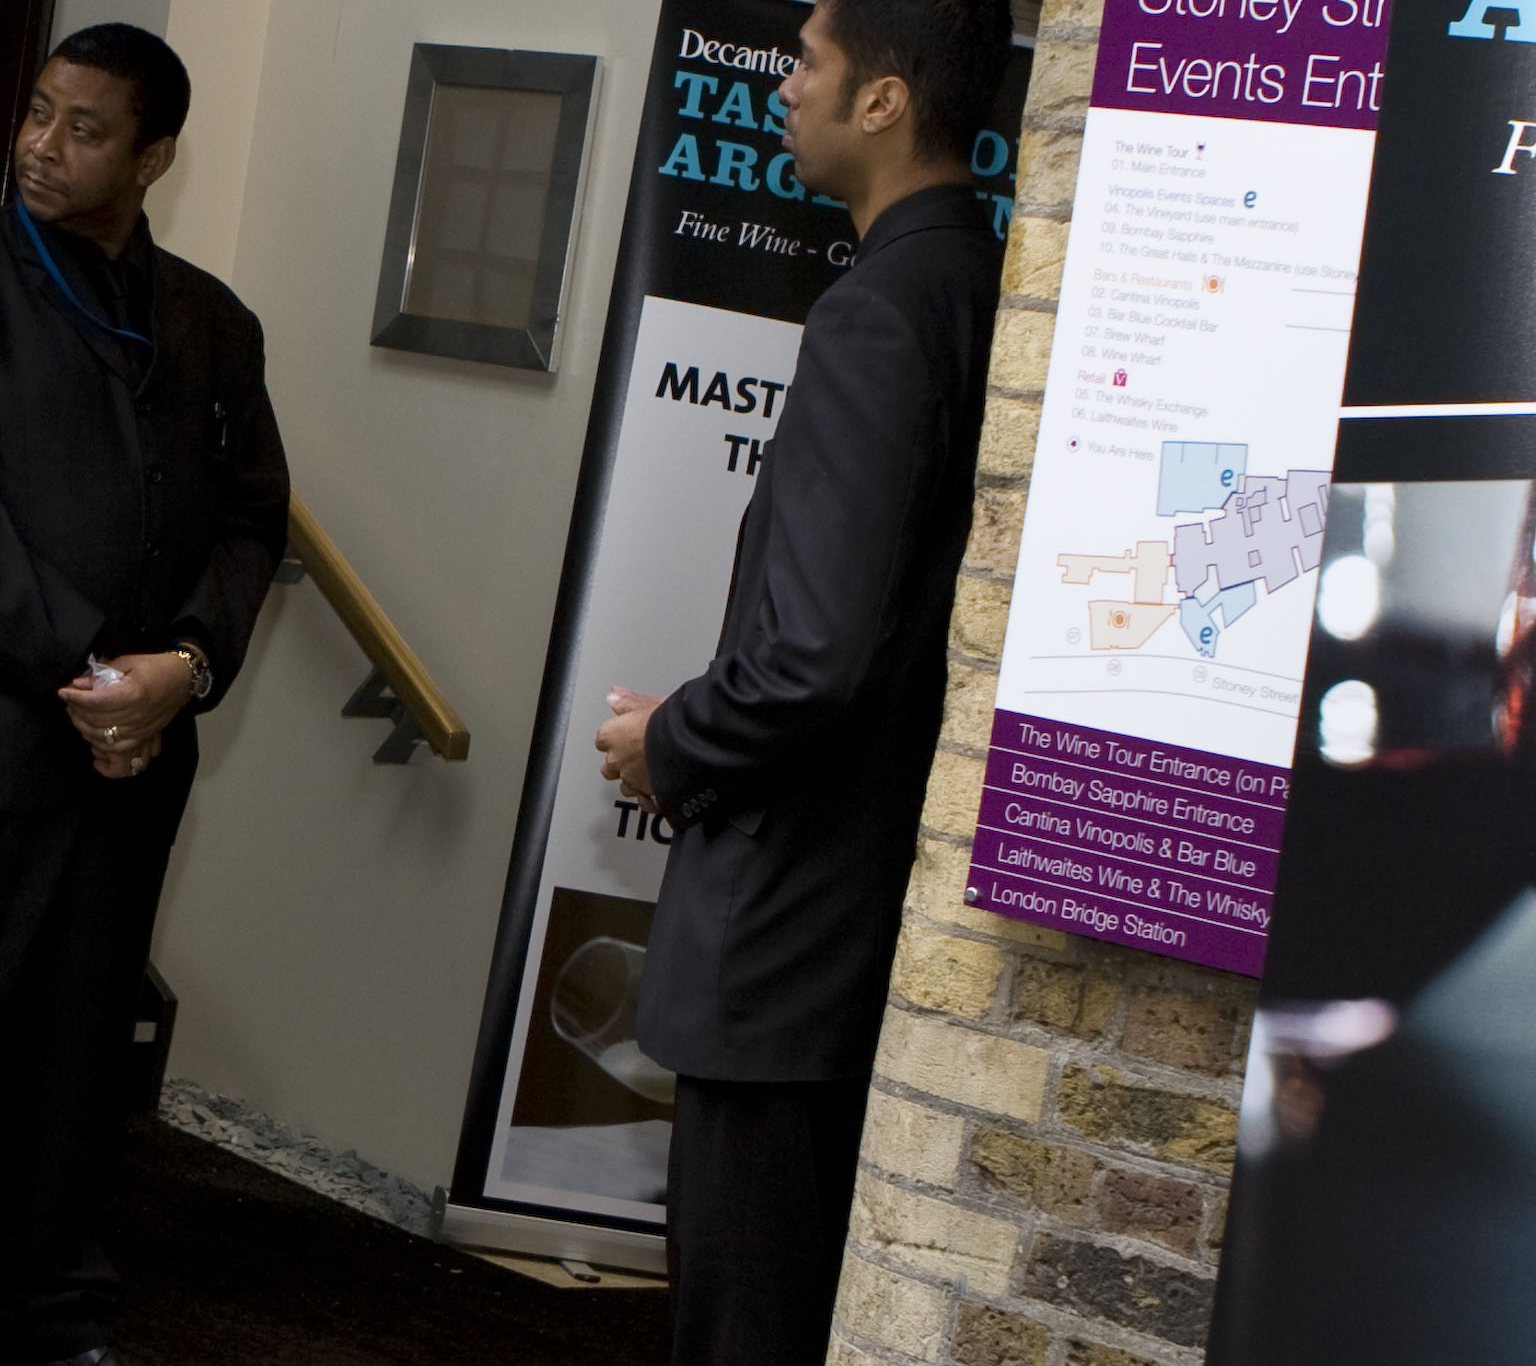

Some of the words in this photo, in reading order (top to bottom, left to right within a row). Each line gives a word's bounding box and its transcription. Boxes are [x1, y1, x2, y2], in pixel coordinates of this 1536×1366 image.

[1126, 41, 1286, 105] Events
[1115, 140, 1134, 155] The
[1136, 143, 1163, 158] Wine
[1165, 145, 1190, 160] Tour
[1131, 161, 1157, 176] Main
[1159, 163, 1207, 179] Entrance
[1108, 184, 1155, 202] Vinopolis
[1156, 190, 1193, 205] Events
[1195, 193, 1236, 209] Spaces
[1125, 203, 1145, 218] The
[1146, 206, 1193, 224] Vineyard
[1219, 215, 1247, 228] main
[674, 209, 731, 244] Fine
[738, 221, 801, 257] Wine
[1121, 223, 1165, 242] Bombay
[1167, 227, 1215, 246] Sapphire
[1119, 242, 1138, 257] The
[1139, 245, 1170, 261] Great
[1212, 252, 1233, 268] The
[1234, 256, 1292, 275] Mezzanine
[1093, 268, 1118, 282] Bars
[1130, 272, 1193, 291] Restaurants
[1110, 289, 1151, 306] Cantina
[1153, 294, 1201, 312] Vinopolis
[1107, 308, 1127, 322] Bar
[1129, 310, 1153, 326] Blue
[1154, 314, 1198, 332] Cocktail
[1199, 319, 1220, 333] Bar
[1104, 327, 1131, 343] Brew
[1131, 331, 1166, 347] Wharf
[1101, 347, 1128, 362] Wine
[1130, 350, 1163, 366] Wharf
[655, 361, 793, 419] MAST
[1077, 370, 1106, 385] Retail
[1095, 390, 1114, 404] The
[1116, 393, 1153, 412] Whisky
[1155, 399, 1209, 419] Exchange
[1090, 410, 1150, 430] Laithwaites
[1151, 418, 1179, 434] Wine
[1087, 441, 1108, 456] You
[1110, 444, 1128, 458] Are
[1129, 447, 1156, 462] Here
[1211, 676, 1258, 699] Stoney
[1259, 686, 1299, 704] Street
[1019, 723, 1052, 749] The
[1056, 730, 1101, 759] Wine
[1104, 740, 1148, 769] Tour
[1149, 750, 1231, 787] Entrance
[1235, 769, 1266, 795] (on
[1011, 763, 1085, 801] Bombay
[1087, 780, 1169, 820] Sapphire
[1173, 797, 1256, 835] Entrance
[1004, 802, 1071, 837] Cantina
[1075, 817, 1155, 855] Vinopolis
[1158, 838, 1172, 860] &
[1177, 841, 1211, 868] Bar
[1213, 850, 1256, 878] Blue
[997, 842, 1093, 883] Laithwaites
[1097, 866, 1144, 895] Wine
[1147, 878, 1161, 900] &
[1167, 881, 1202, 910] The
[1205, 891, 1272, 929] Whisky
[990, 882, 1057, 917] London
[1060, 899, 1119, 933] Bridge
[1122, 914, 1186, 948] Station
